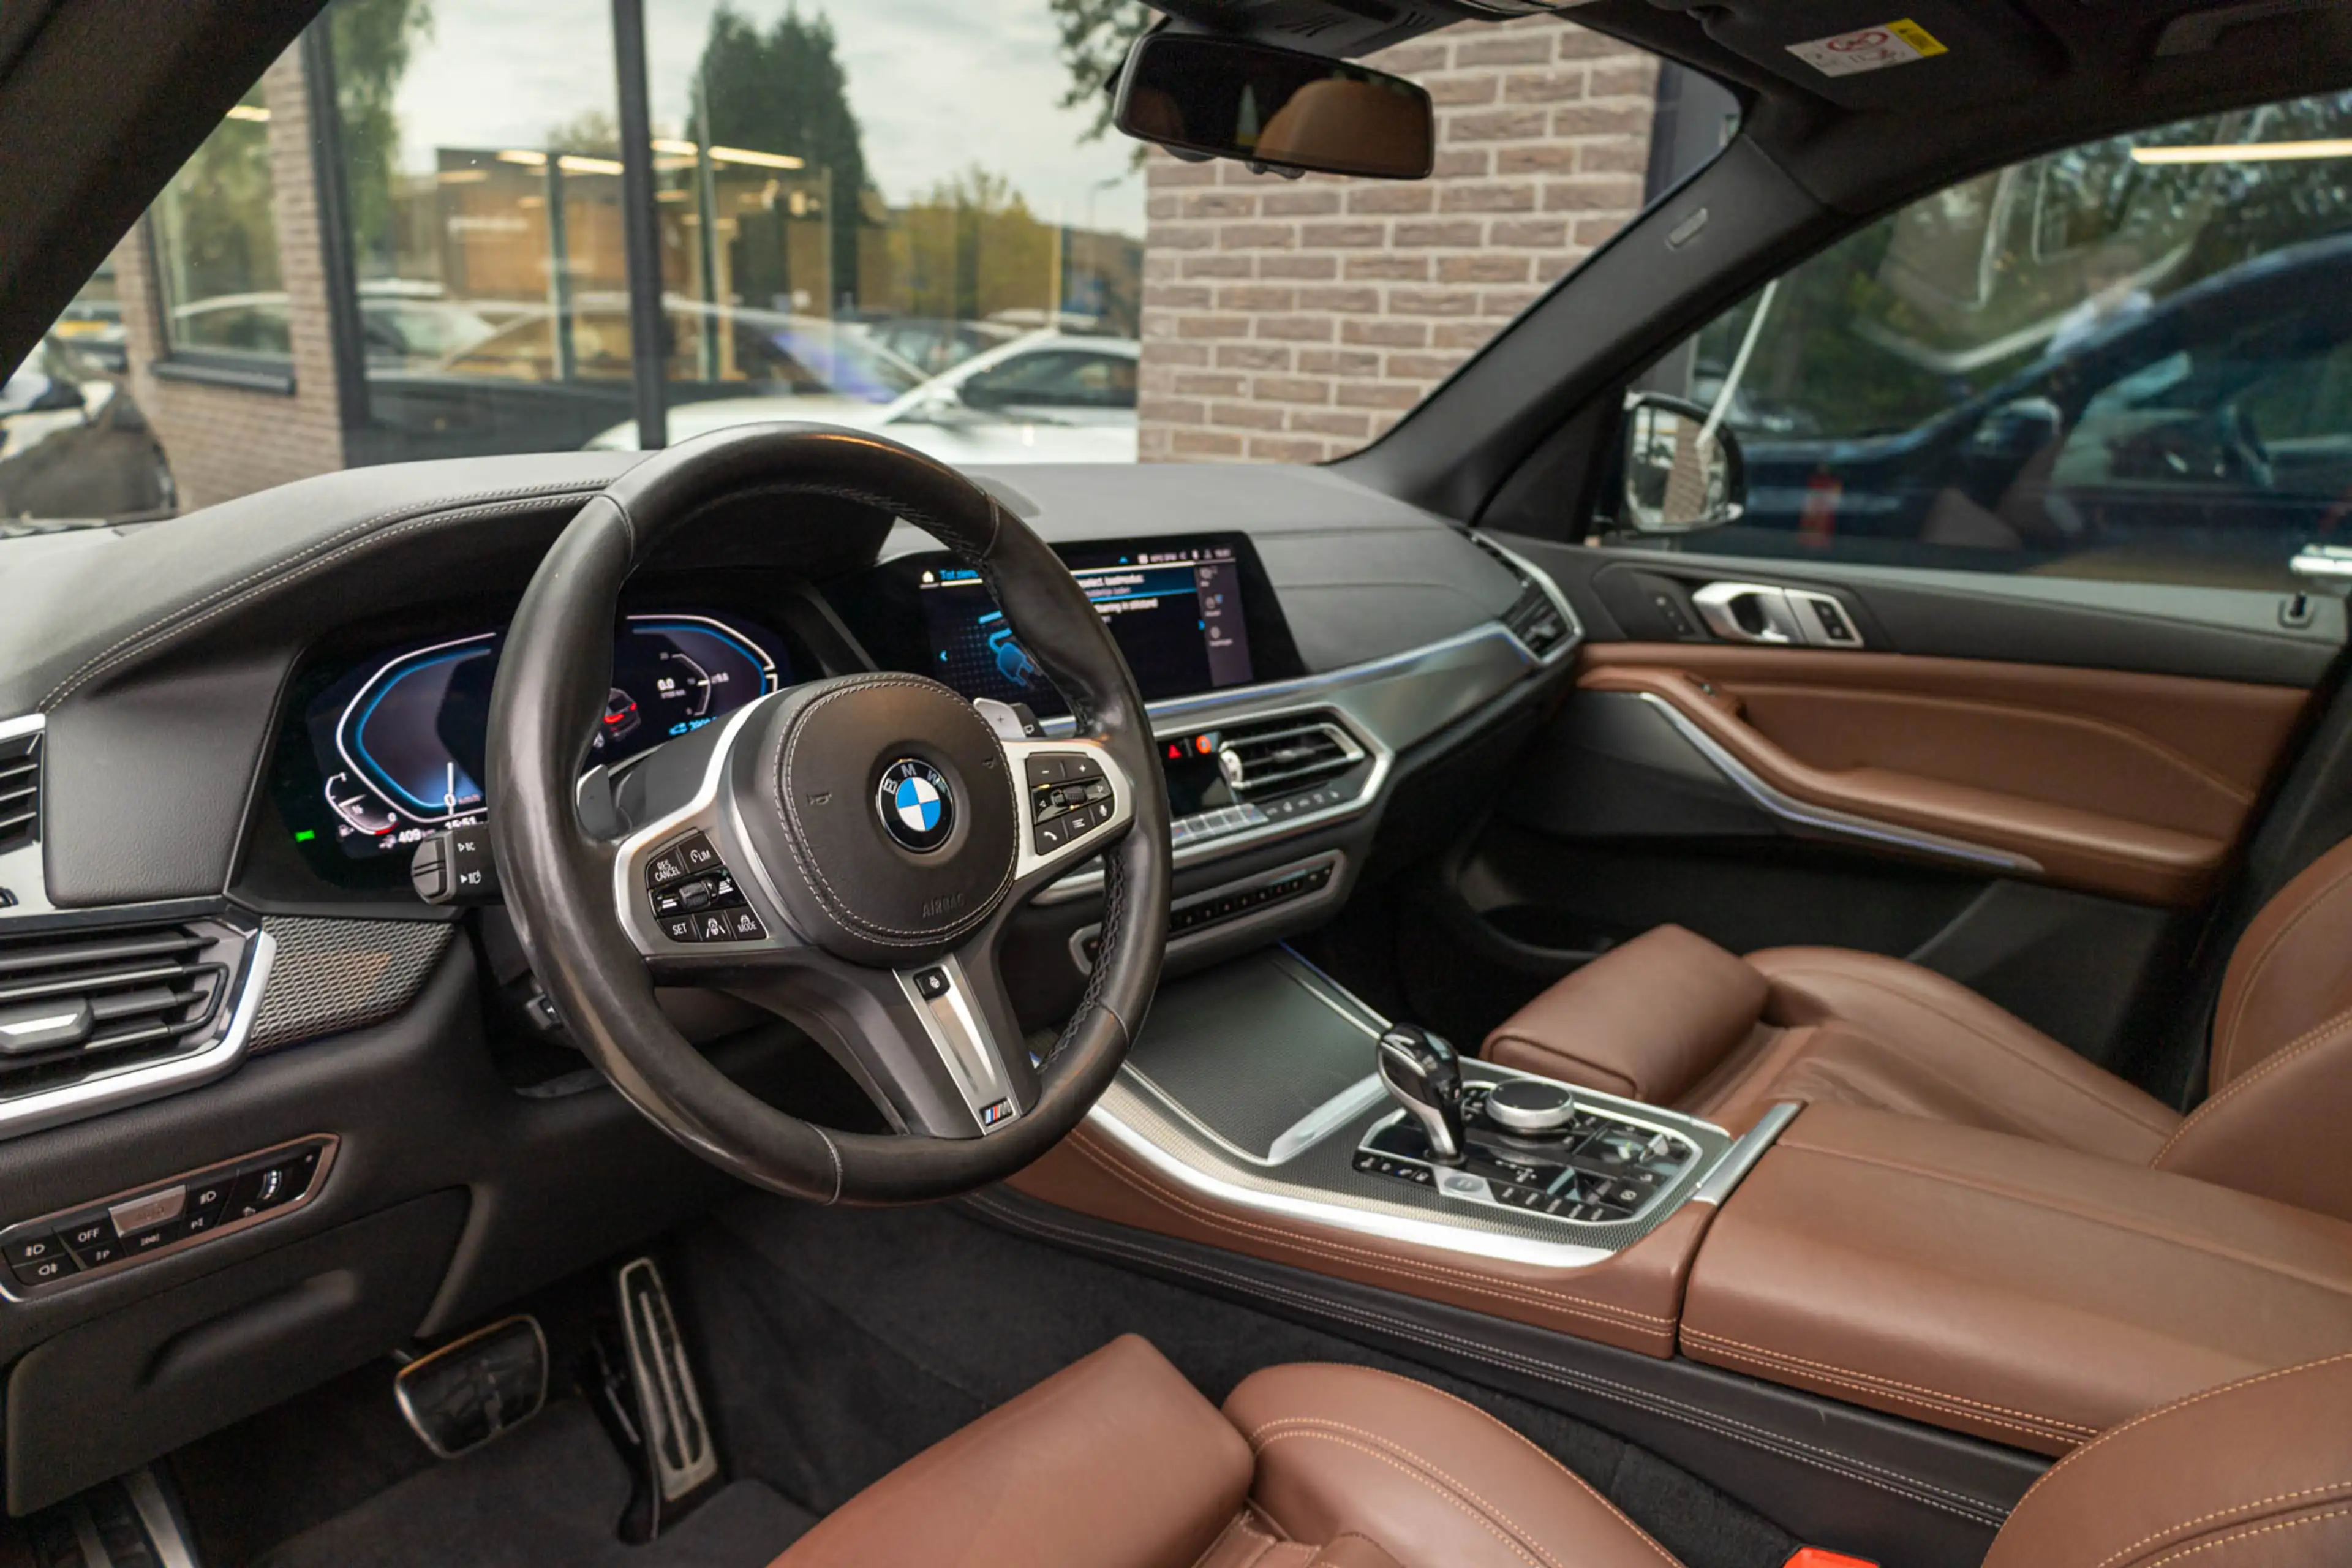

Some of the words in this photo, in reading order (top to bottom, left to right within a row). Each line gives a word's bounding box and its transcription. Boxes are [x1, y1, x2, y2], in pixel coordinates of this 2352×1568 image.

[883, 763, 940, 795] BMW
[657, 859, 672, 871] RES
[654, 867, 681, 882] CANCEL
[672, 922, 688, 936] SET
[737, 921, 758, 933] MODE
[78, 1227, 100, 1243] OFF
